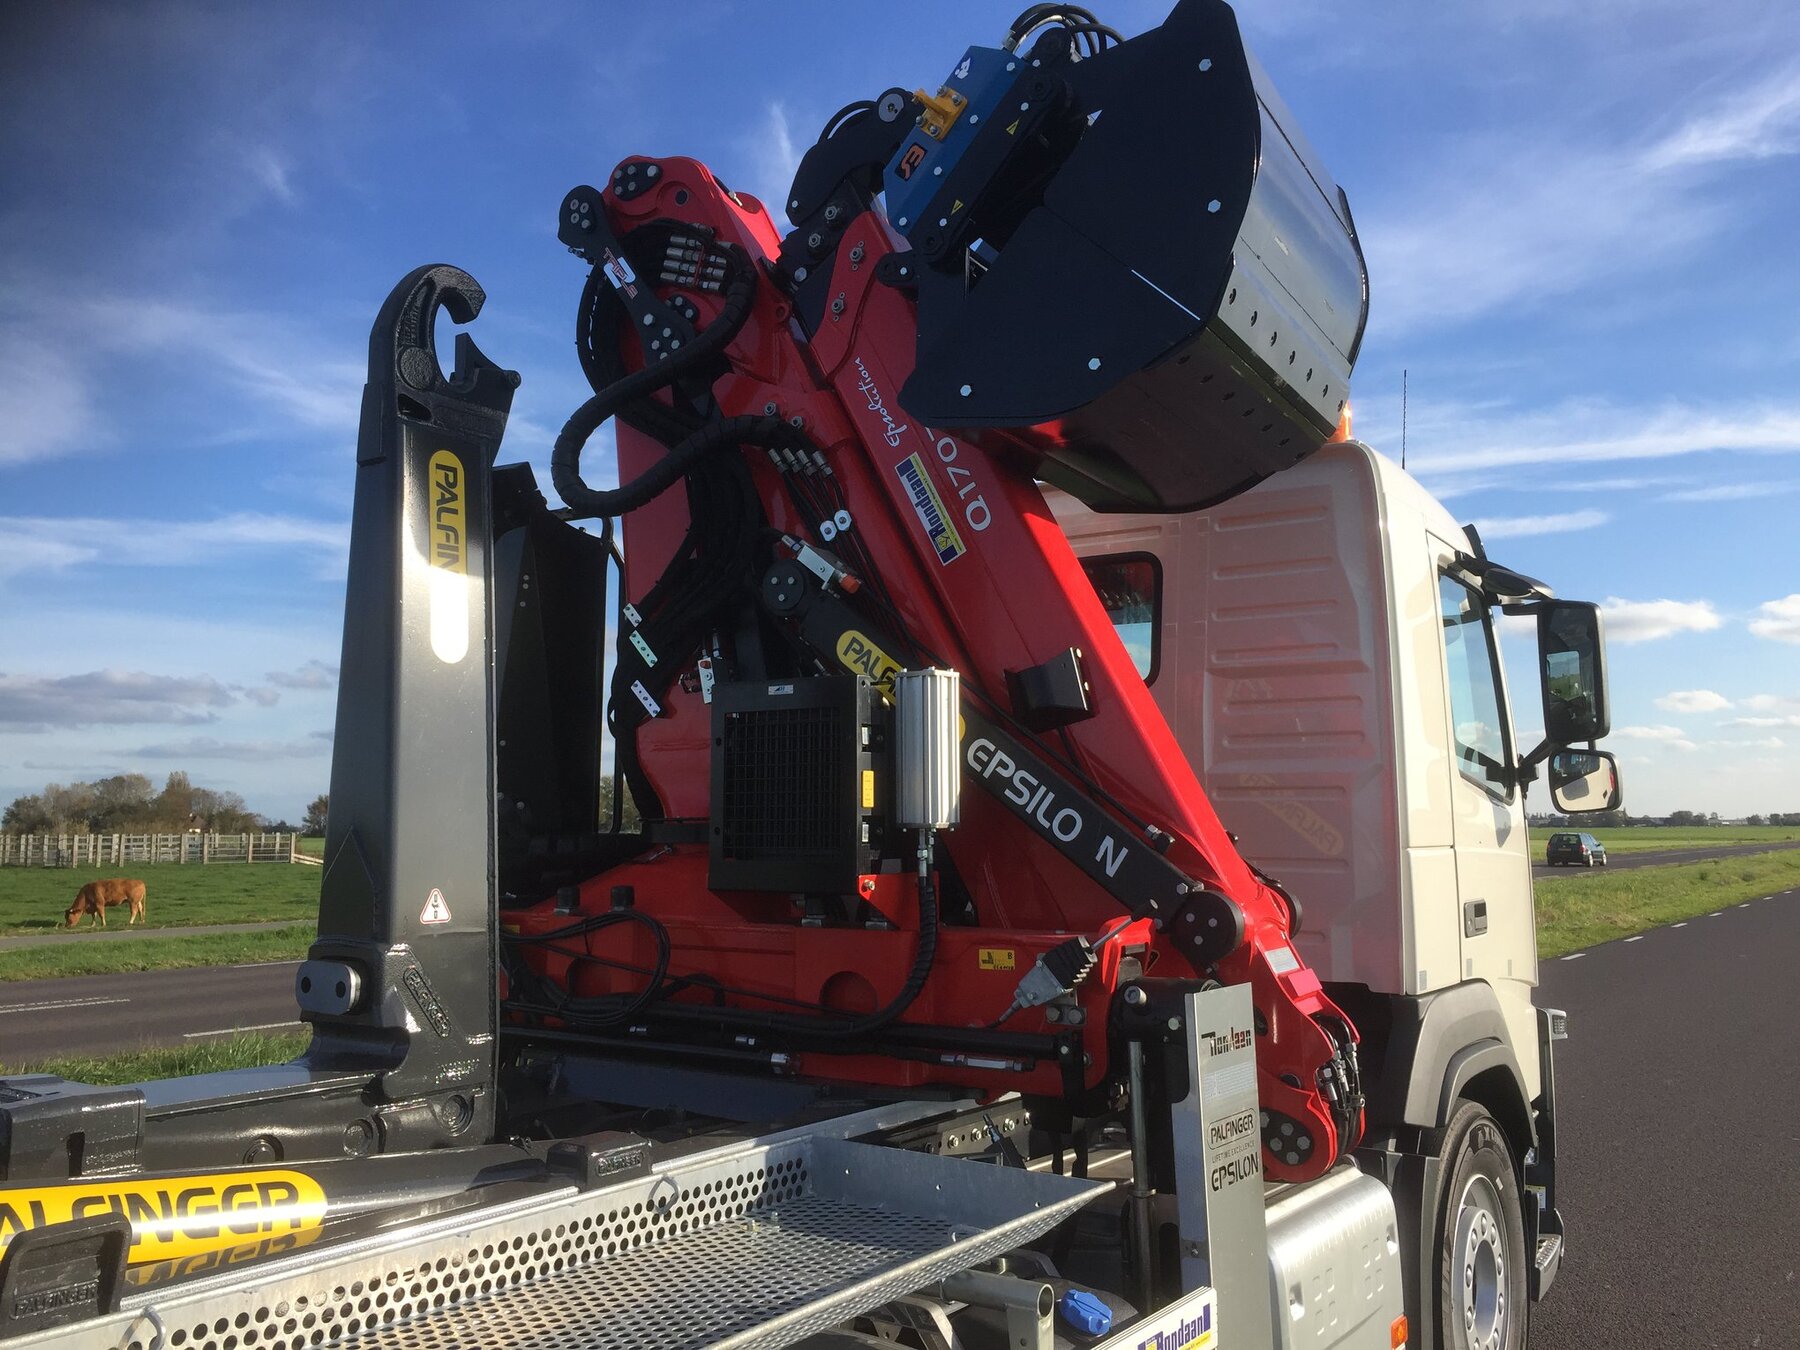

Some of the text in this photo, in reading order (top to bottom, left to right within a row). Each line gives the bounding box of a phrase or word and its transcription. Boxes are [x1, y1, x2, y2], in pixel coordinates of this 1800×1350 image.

[905, 468, 947, 541] Rondaan
[842, 636, 896, 698] PALF
[1210, 1114, 1254, 1144] PALFINGER
[1211, 1151, 1259, 1192] EPSILON
